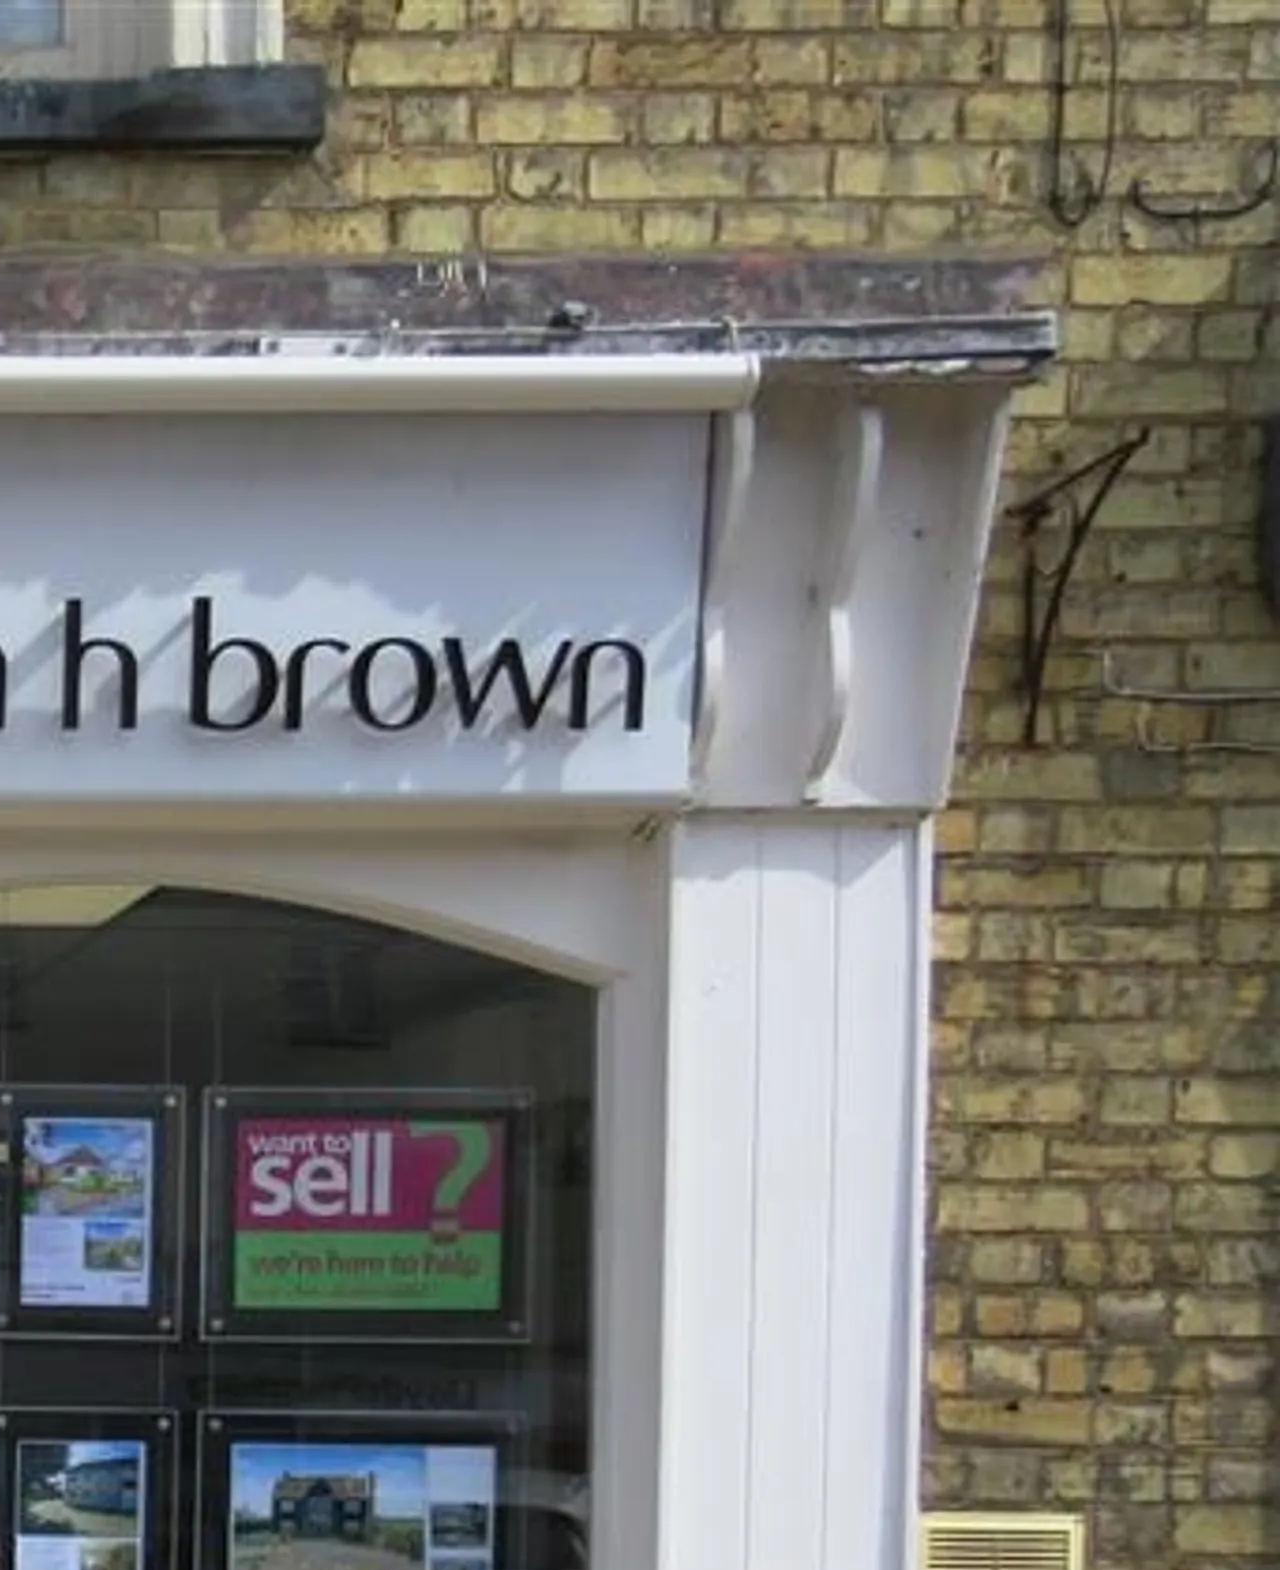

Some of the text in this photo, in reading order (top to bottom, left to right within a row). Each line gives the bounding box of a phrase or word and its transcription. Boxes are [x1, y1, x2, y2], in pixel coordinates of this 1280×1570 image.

[61, 600, 139, 731] h
[191, 597, 645, 732] brown
[249, 1132, 352, 1154] want to
[249, 1130, 393, 1217] sell
